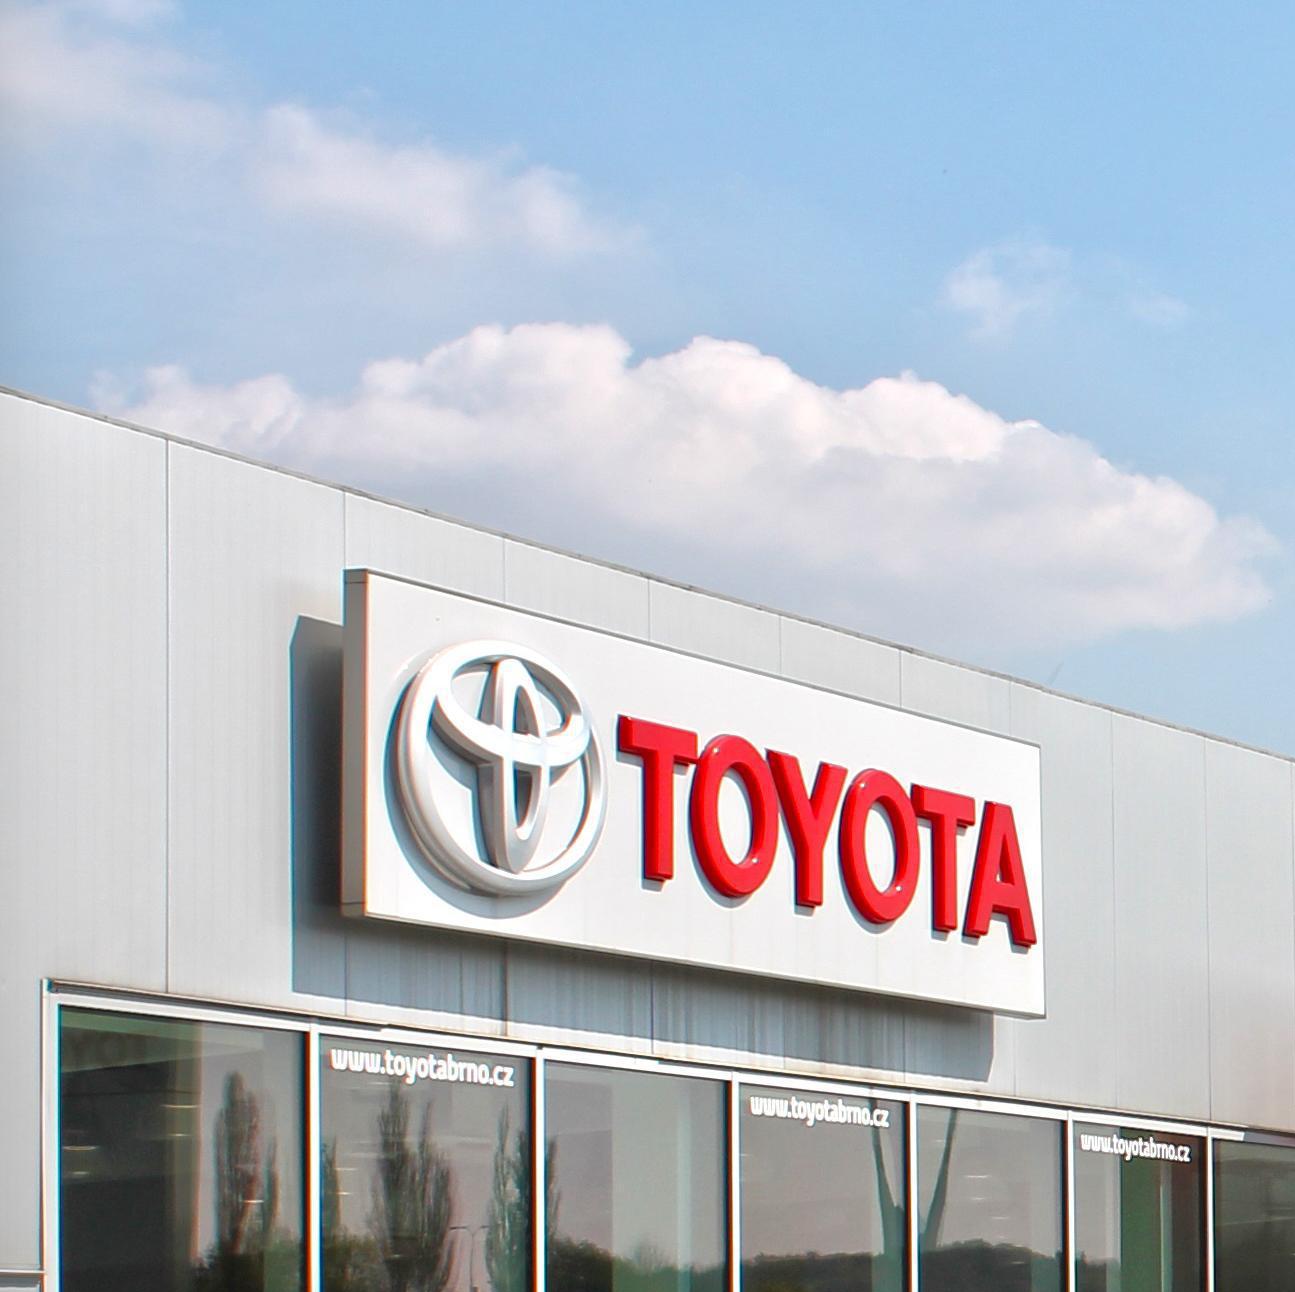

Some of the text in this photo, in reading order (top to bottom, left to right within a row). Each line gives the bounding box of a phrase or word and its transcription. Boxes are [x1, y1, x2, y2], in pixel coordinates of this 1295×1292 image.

[617, 714, 1037, 948] TOYOTA
[330, 1048, 515, 1087] www.toyotabrno.cz
[750, 1095, 890, 1128] www.toyotabrno.cz
[1080, 1134, 1191, 1162] www.toyotabrno.cz
